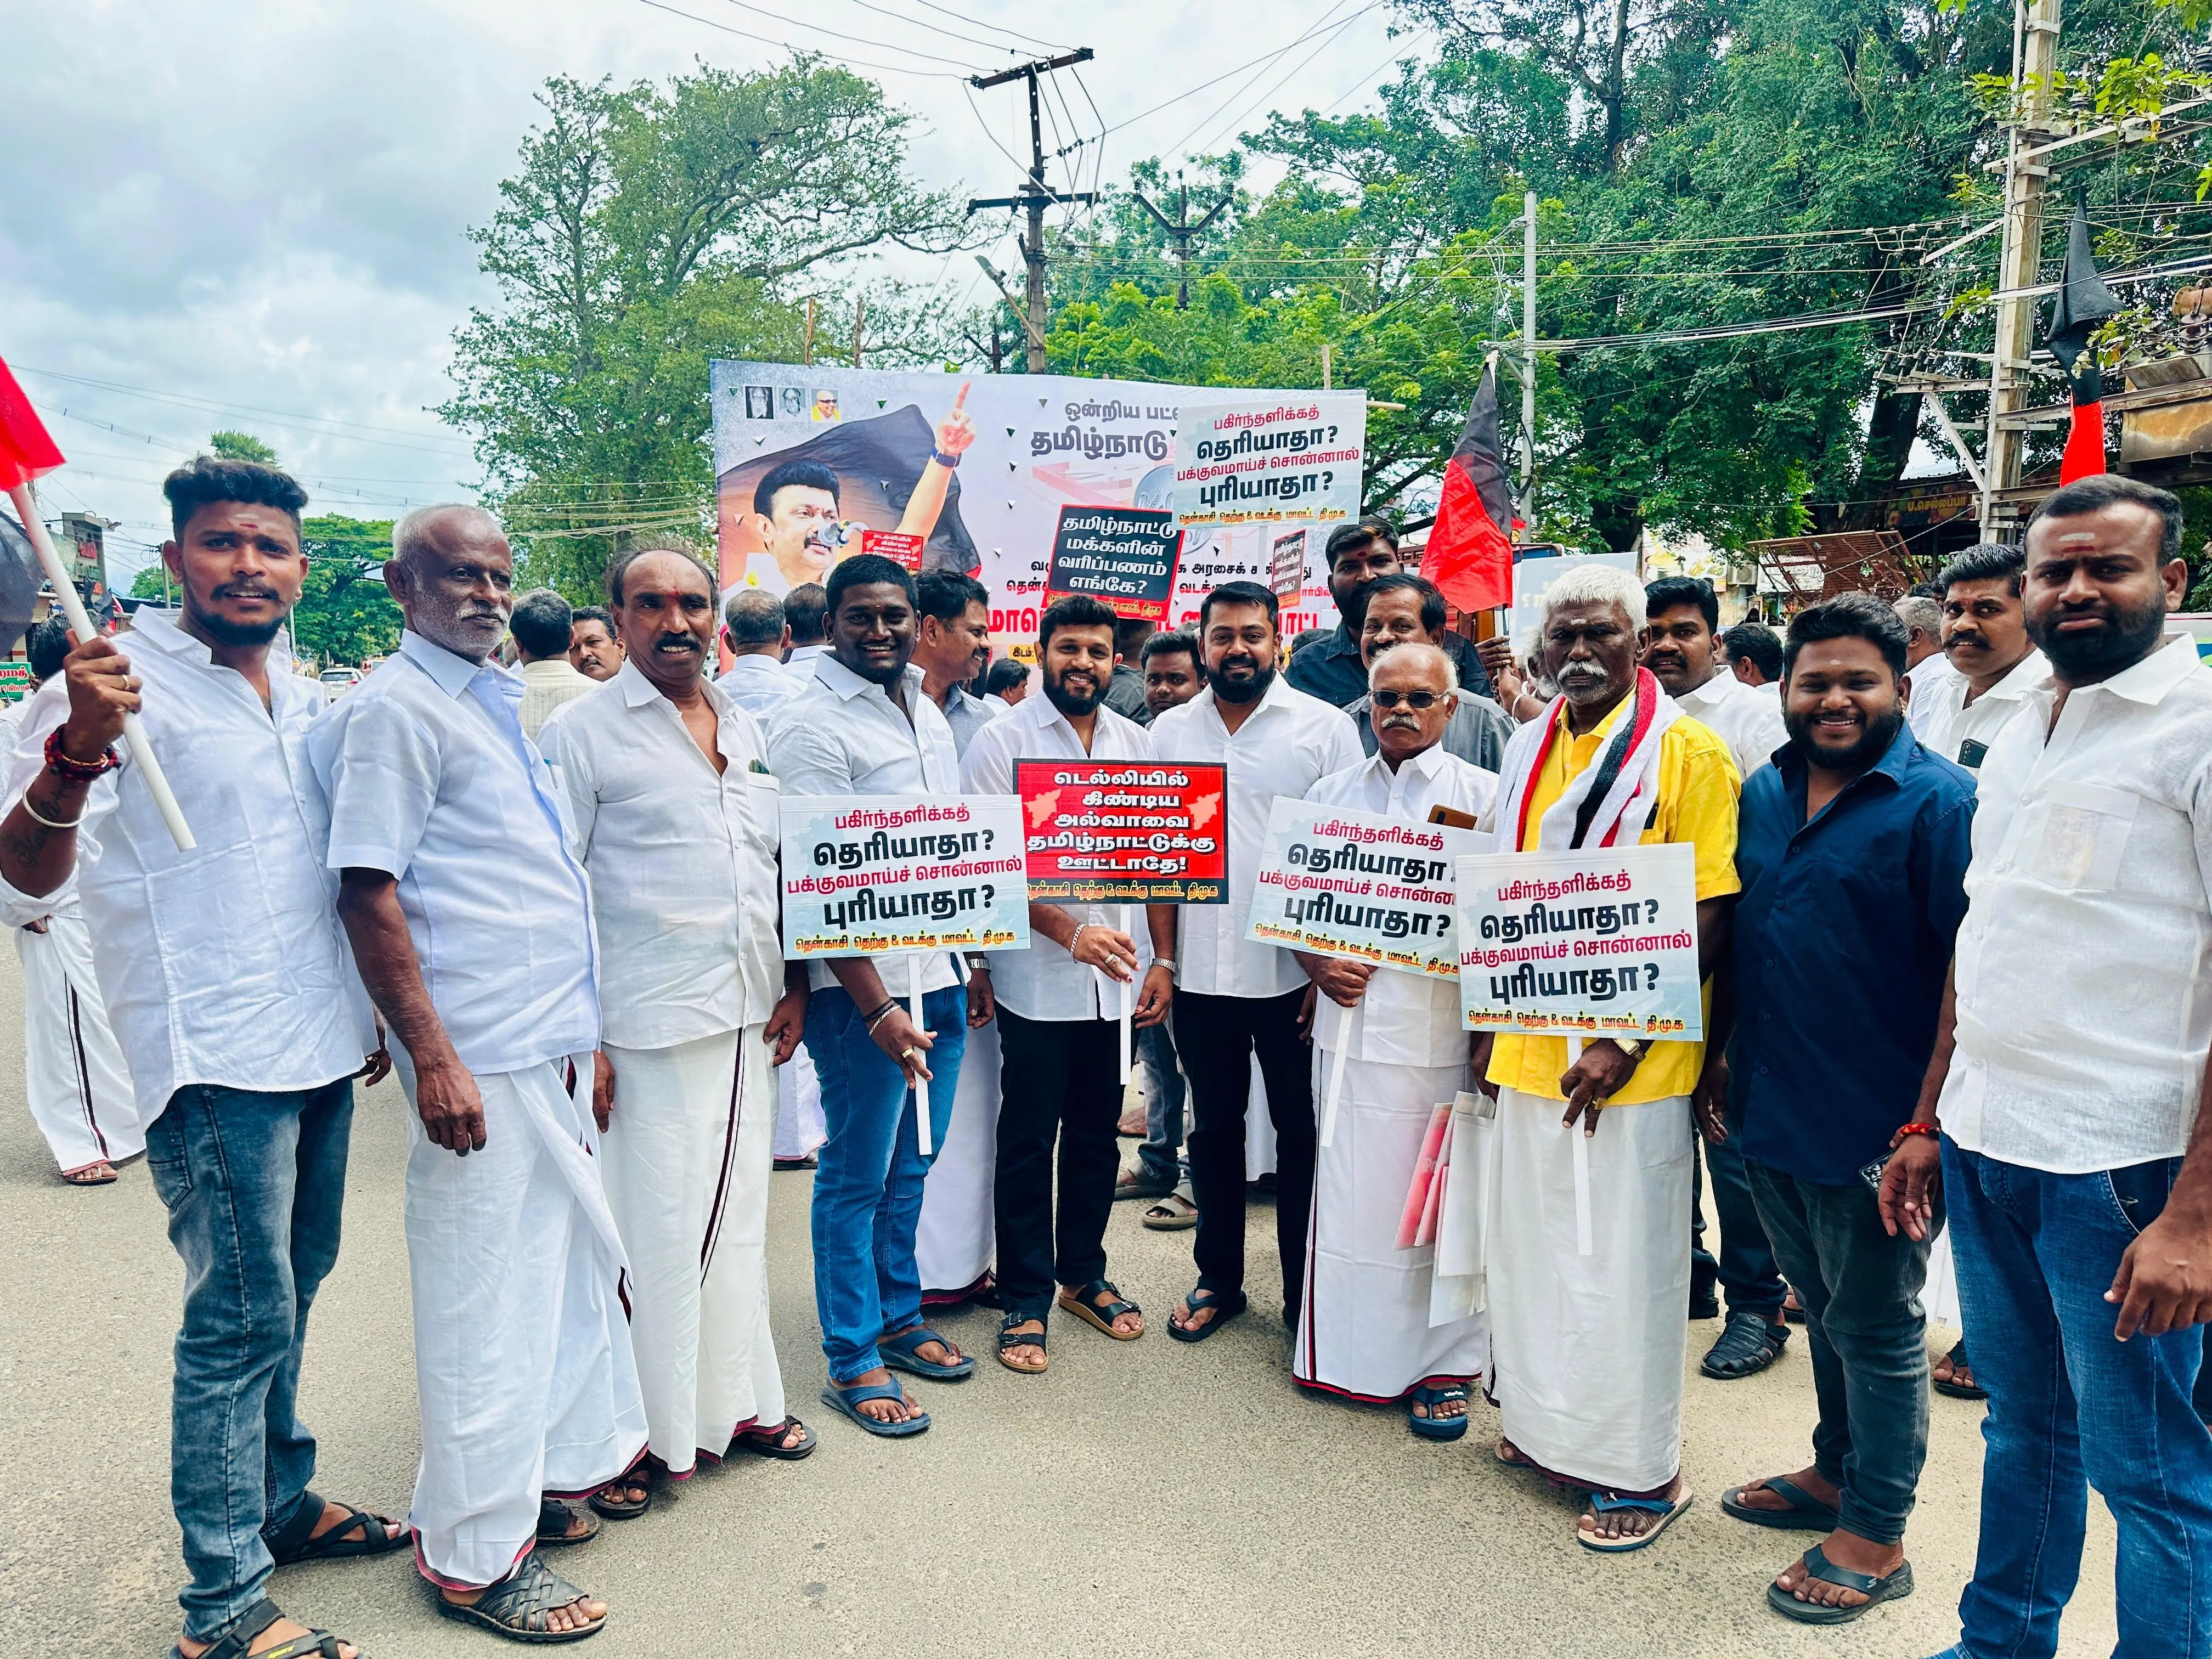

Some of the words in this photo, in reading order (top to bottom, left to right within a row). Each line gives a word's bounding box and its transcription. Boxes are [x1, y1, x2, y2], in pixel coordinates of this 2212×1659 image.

[1065, 398, 1141, 422] ஒன்றிய
[1214, 404, 1319, 430] பகிர்ந்தளிக்கத்
[1031, 425, 1168, 461] தமிழ்நாடு
[1197, 426, 1339, 462] தெரியாதா?
[1177, 458, 1267, 481] பக்குவமாய்ச்
[1270, 446, 1359, 469] சொன்னால்
[1200, 471, 1333, 509] புரியாதா?
[1062, 516, 1177, 539] தமிழ்நாட்டு
[1180, 511, 1216, 526] தென்காசி
[1220, 509, 1245, 523] தெற்கு
[1247, 511, 1253, 520] &
[1255, 508, 1282, 520] வடக்கு
[1286, 507, 1314, 518] மாவட்ட
[1066, 535, 1166, 558] மக்களின்
[1058, 554, 1167, 577] வரிப்பணம்
[1192, 563, 1245, 577] அரசைக்
[1069, 576, 1148, 595] எங்கே?
[1054, 769, 1189, 788] டெல்லியில்
[1082, 791, 1180, 809] கிண்டிய
[835, 802, 970, 828] பகிர்ந்தளிக்கத்
[1054, 810, 1189, 830] அல்வாவை
[1027, 833, 1216, 853] தமிழ்நாட்டுக்கு
[1313, 820, 1444, 851] பகிர்ந்தளிக்கத்
[813, 829, 994, 871] தெரியாதா?
[788, 864, 911, 894] பக்குவமாய்ச்
[916, 854, 1022, 880] சொன்னால்
[1057, 855, 1187, 873] ஊட்டாதே!
[1288, 843, 1455, 884] தெரியாதா
[1074, 880, 1105, 900] தெற்கு
[1106, 884, 1115, 896] &
[1116, 880, 1148, 898] வடக்கு
[1152, 881, 1184, 896] மாவட்ட
[1260, 869, 1372, 899] பக்குவமாய்ச்
[1498, 870, 1632, 902] பகிர்ந்தளிக்கத்
[823, 884, 994, 930] புரியாதா?
[1284, 891, 1451, 938] புரியாதா?
[1481, 899, 1660, 944] தெரியாதா?
[795, 934, 848, 953] தென்காசி
[854, 932, 888, 951] தெற்கு
[891, 936, 900, 945] &
[902, 930, 936, 946] வடக்கு
[942, 929, 977, 943] மாவட்ட
[983, 929, 1014, 945] தி.மு.க
[1255, 923, 1301, 941] தென்காசி
[1306, 932, 1336, 950] தெற்கு
[1340, 940, 1346, 951] &
[1350, 942, 1382, 960] வடக்கு
[1387, 951, 1421, 966] மாவட்ட
[1460, 937, 1571, 967] பக்குவமாய்ச்
[1574, 929, 1692, 956] சொன்னால்
[1490, 963, 1660, 1006] புரியாதா?
[1469, 1008, 1512, 1025] தென்காசி
[1517, 1009, 1548, 1028] தெற்கு
[1551, 1013, 1559, 1025] &
[1562, 1011, 1596, 1029] வடக்கு
[1602, 1012, 1640, 1029] மாவட்ட
[1647, 1015, 1684, 1033] தி.மு.க
